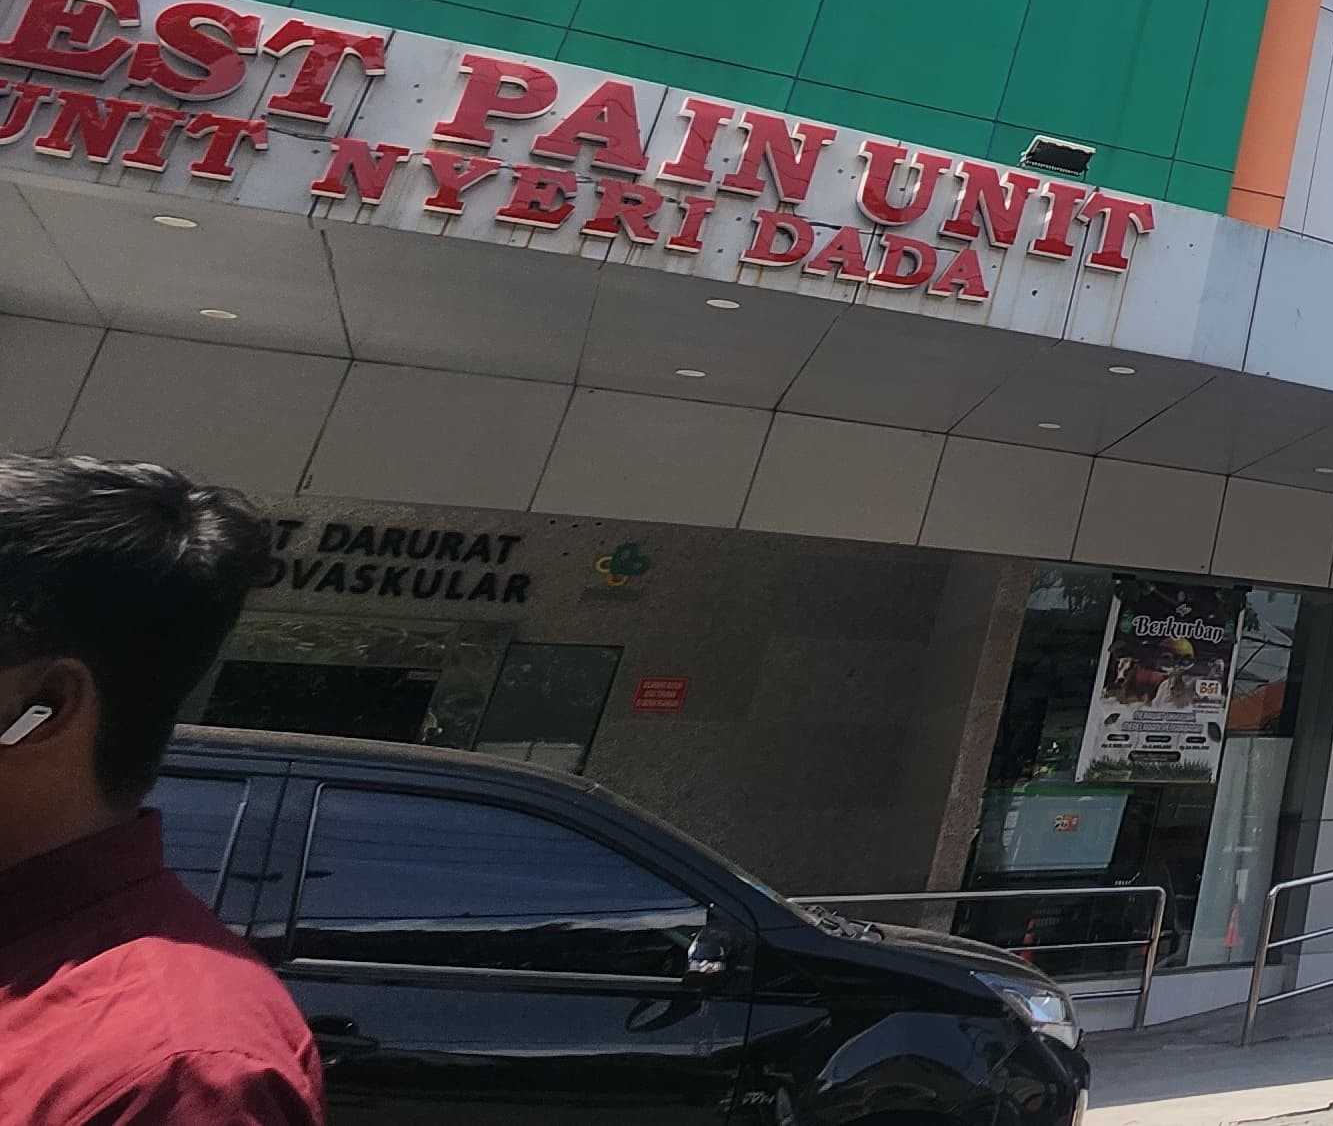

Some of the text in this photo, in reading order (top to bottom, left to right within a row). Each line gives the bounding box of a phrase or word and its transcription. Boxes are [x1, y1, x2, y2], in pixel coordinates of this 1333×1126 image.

[431, 53, 837, 204] PAIN
[857, 139, 1153, 274] UNIT
[310, 136, 717, 255] NYERI
[740, 208, 991, 303] DADA
[317, 522, 522, 565] DARURAT
[1132, 615, 1225, 644] Berkurban
